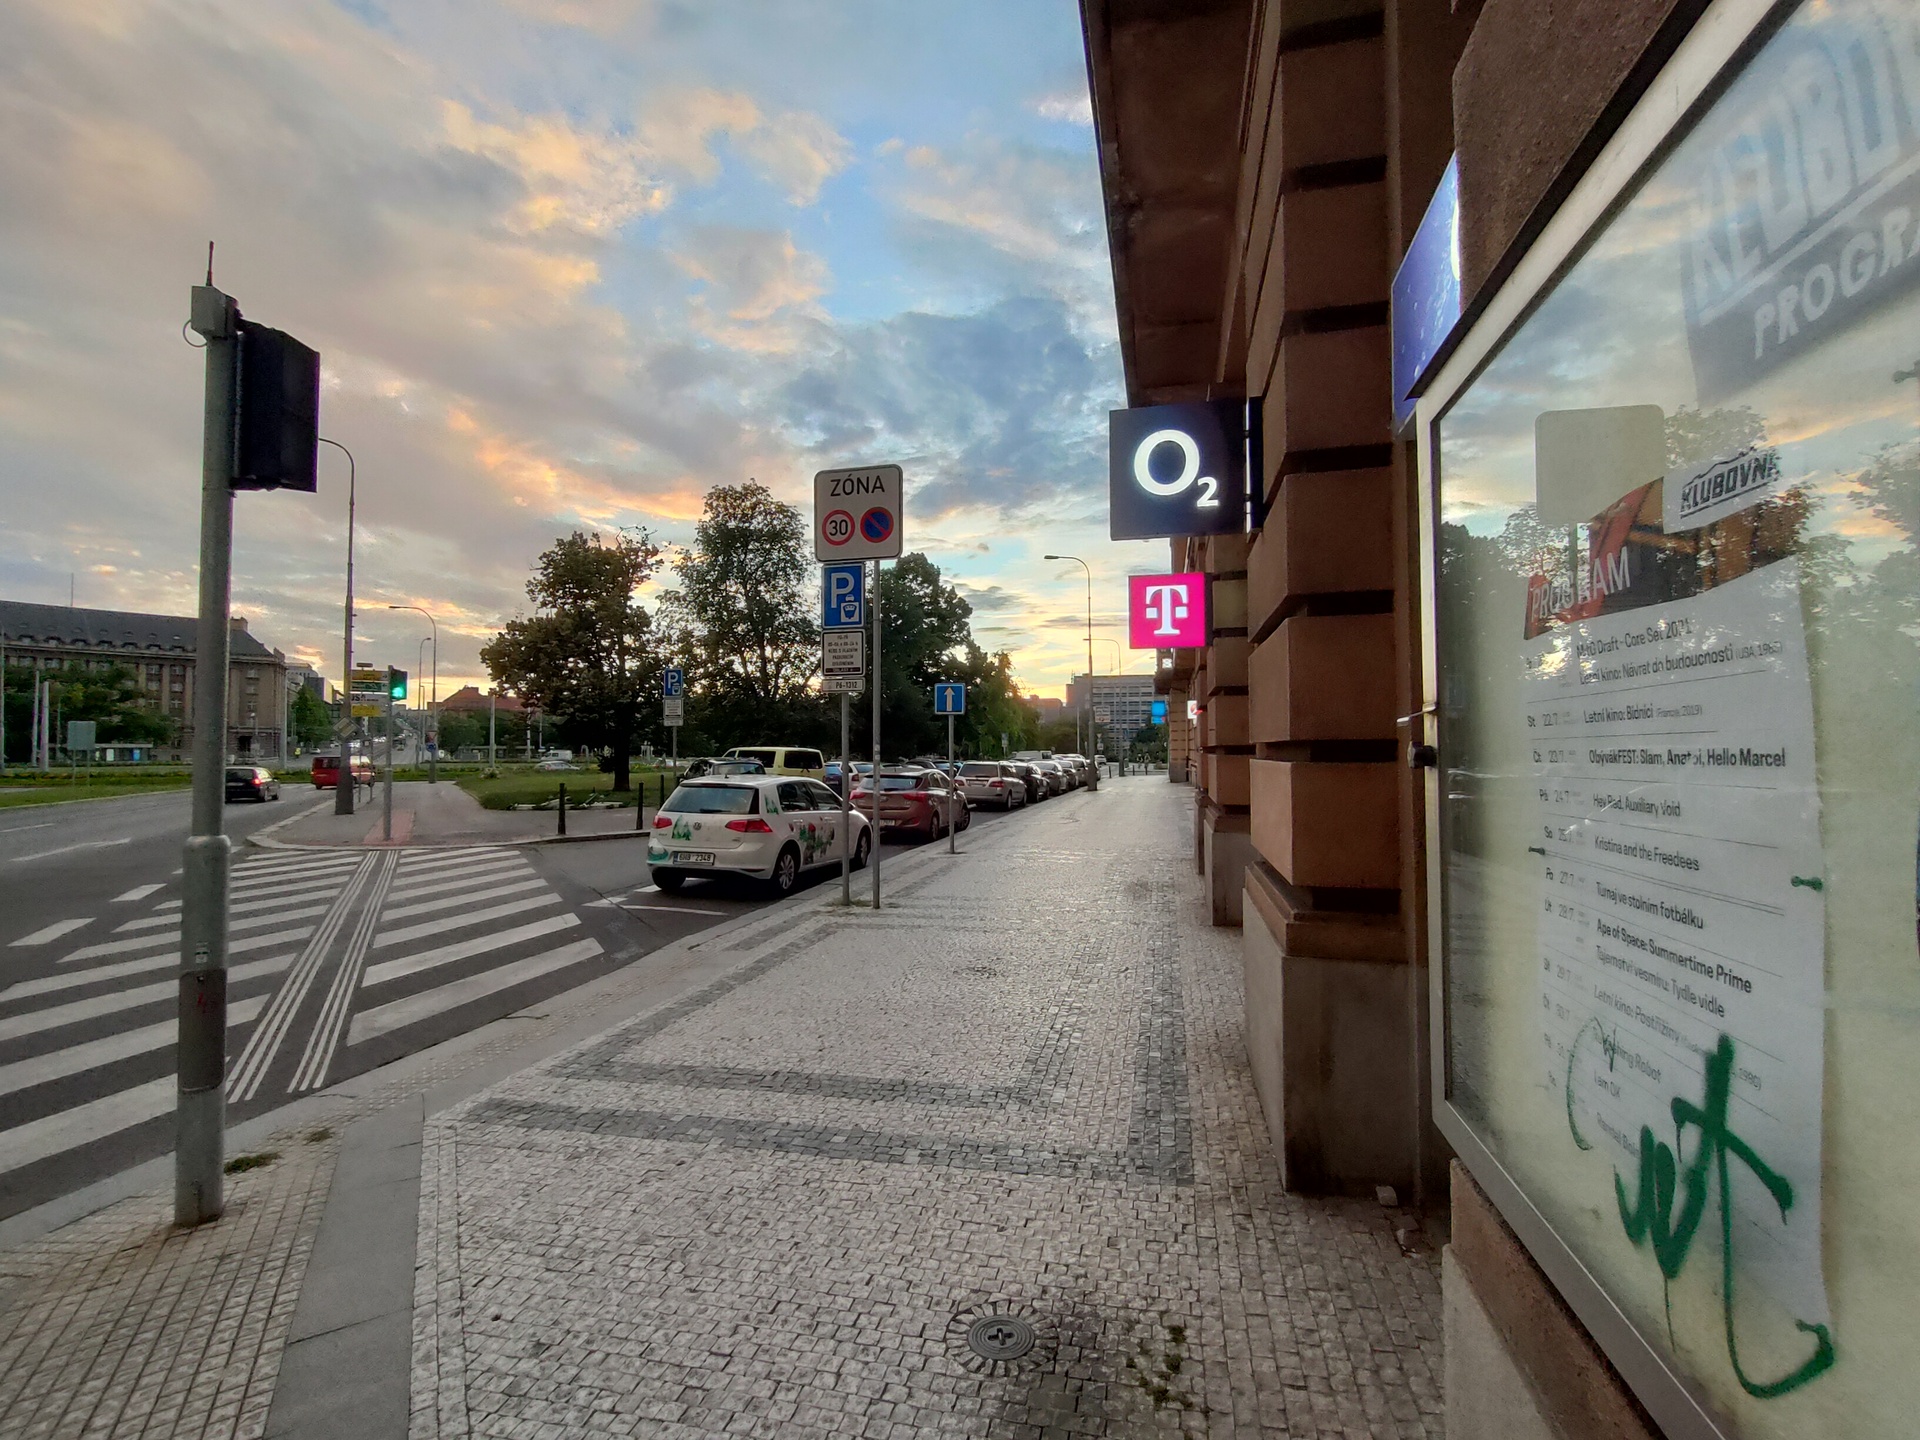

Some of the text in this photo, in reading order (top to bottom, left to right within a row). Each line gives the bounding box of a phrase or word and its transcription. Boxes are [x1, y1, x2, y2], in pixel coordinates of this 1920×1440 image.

[830, 474, 886, 497] ZÓNA
[828, 519, 849, 537] 30
[831, 572, 855, 609] P
[1597, 636, 1620, 655] Draft
[1624, 631, 1646, 648] Core
[1646, 626, 1664, 643] Set
[1600, 665, 1623, 682] kino:
[1622, 660, 1651, 679] Návrat
[1652, 656, 1665, 673] do
[1665, 643, 1734, 672] budoucnosti
[667, 671, 679, 689] P
[1583, 708, 1605, 724] Letní
[1605, 706, 1626, 722] kino:
[1588, 749, 1639, 768] ObývákFEST:
[1640, 747, 1665, 768] Slam,
[1706, 747, 1738, 767] Hello
[1739, 746, 1787, 768] Marcel
[1594, 835, 1622, 855] Kristina
[1623, 842, 1638, 858] and
[1638, 845, 1653, 862] the
[1653, 845, 1701, 872] Freedees
[1618, 891, 1628, 906] ve
[1660, 900, 1705, 930] fotbálku
[1596, 917, 1612, 938] Ape
[1612, 923, 1621, 940] of
[1648, 937, 1714, 979] Summertime
[1715, 963, 1753, 995] Prime
[1670, 978, 1698, 1005] Tydle
[1698, 990, 1726, 1018] vidle
